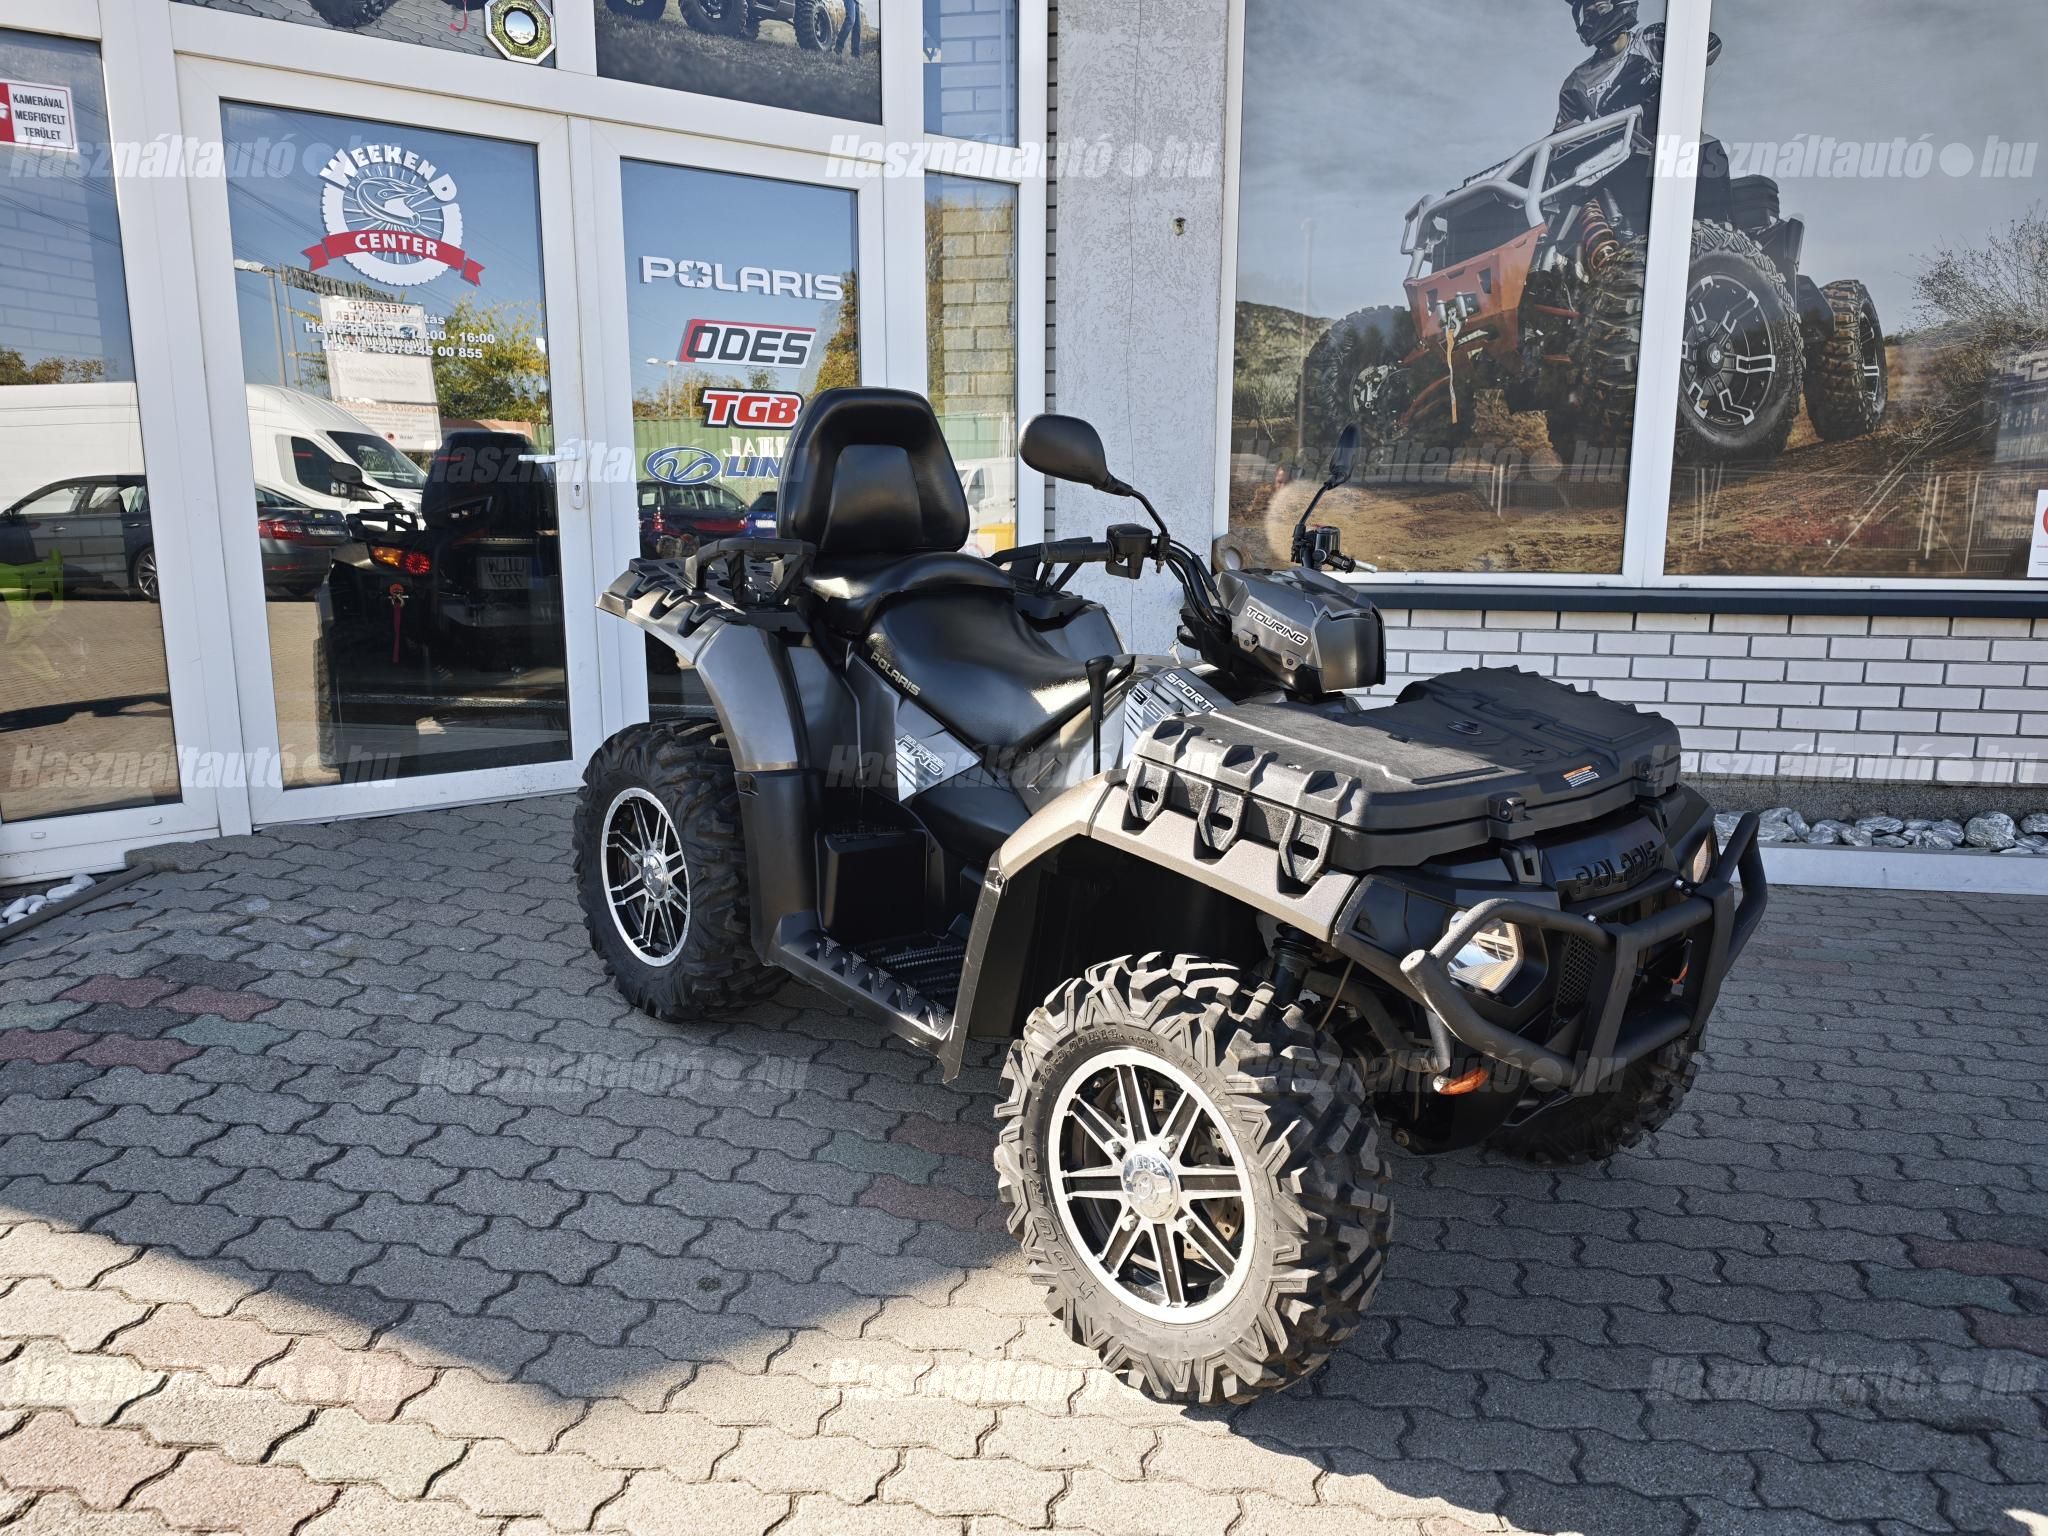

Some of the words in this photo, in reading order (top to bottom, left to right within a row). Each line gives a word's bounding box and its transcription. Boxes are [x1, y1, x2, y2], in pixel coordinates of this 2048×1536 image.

[12, 93, 65, 110] KAMERÁVAL
[14, 109, 66, 126] MEGFIGYELT
[23, 126, 62, 140] TERÜLET
[320, 144, 458, 202] WEEKEND
[354, 232, 439, 257] CENTER
[642, 255, 844, 301] POLARIS
[437, 347, 455, 358] 00
[458, 347, 484, 359] 855
[458, 331, 496, 345] 16:00
[686, 323, 812, 366] ODES
[706, 391, 801, 428] TGB
[1245, 604, 1309, 647] TOURING
[869, 650, 922, 698] POLARIS
[896, 737, 945, 776] AWD
[1574, 840, 1657, 892] POLARIS
